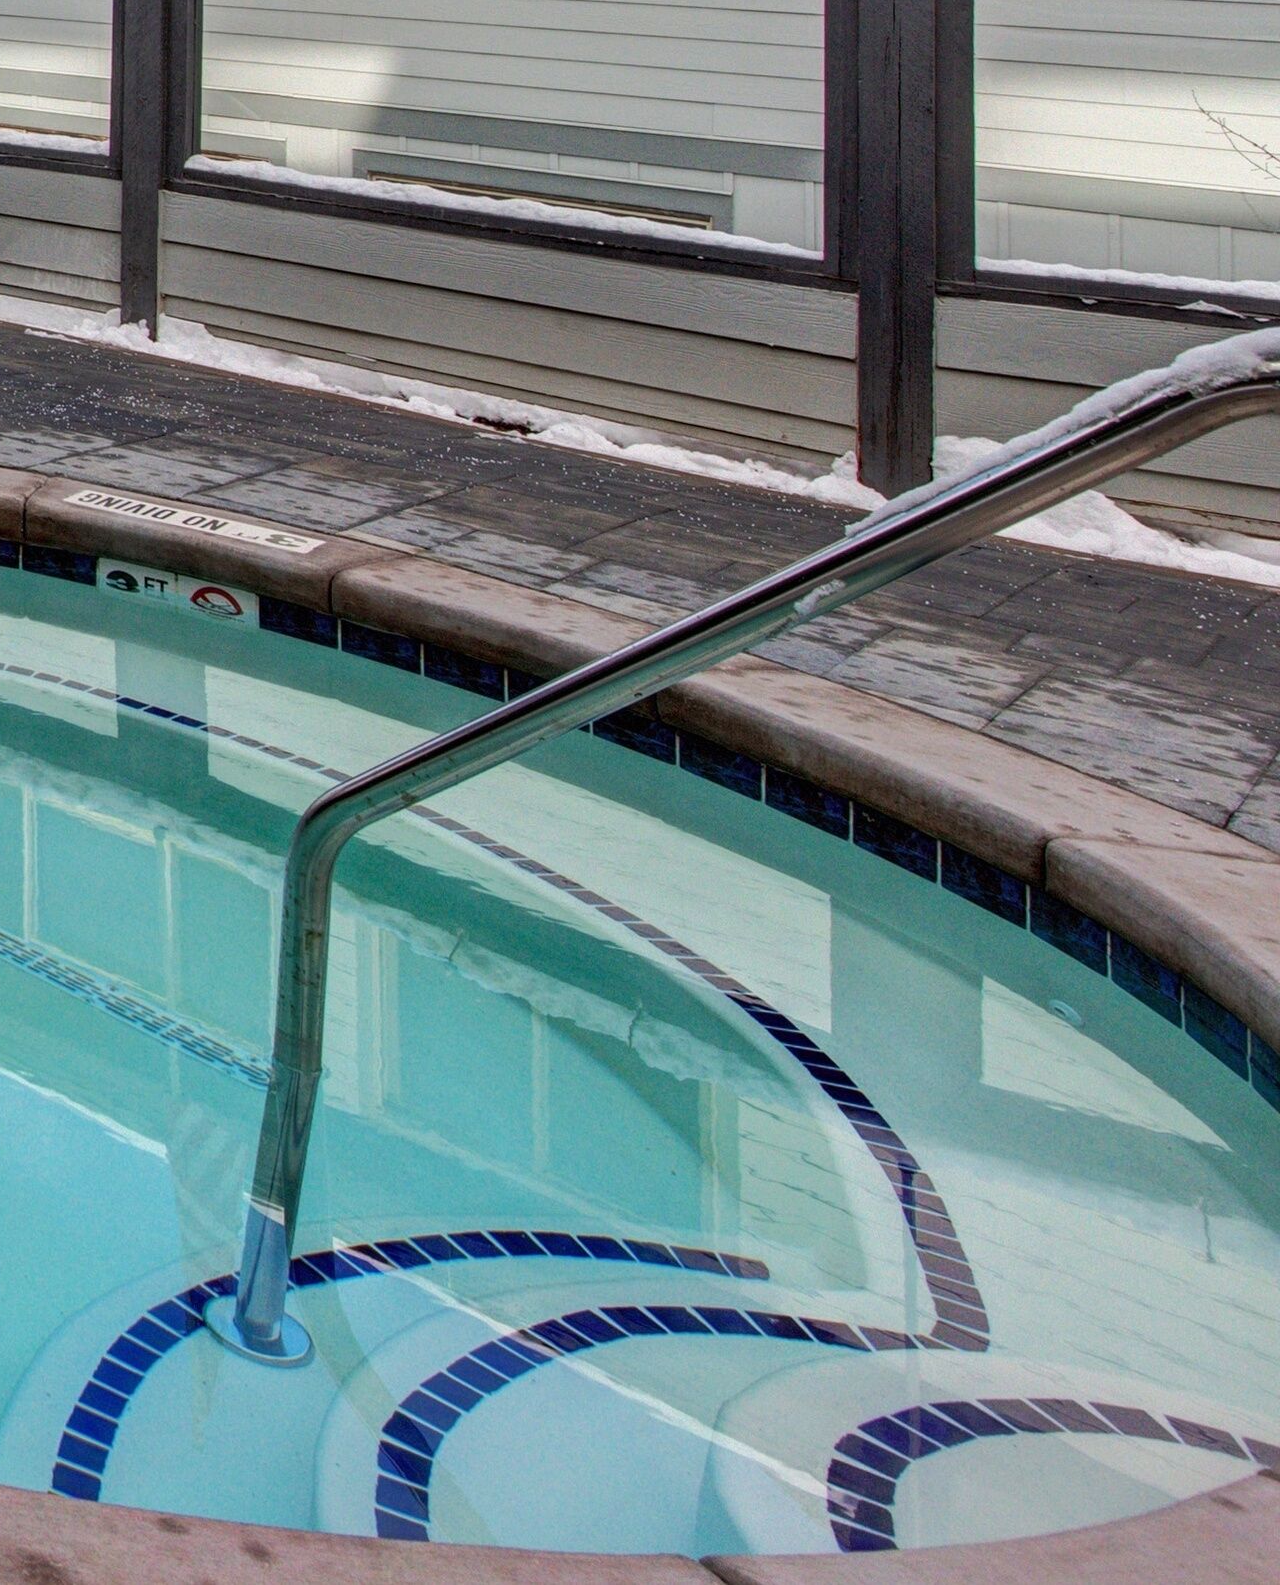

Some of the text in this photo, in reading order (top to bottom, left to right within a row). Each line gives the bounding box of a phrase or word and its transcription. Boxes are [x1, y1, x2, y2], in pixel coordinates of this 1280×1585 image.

[78, 492, 177, 520] DIVING
[182, 515, 228, 531] NO
[265, 534, 308, 548] 3
[144, 576, 169, 593] FT
